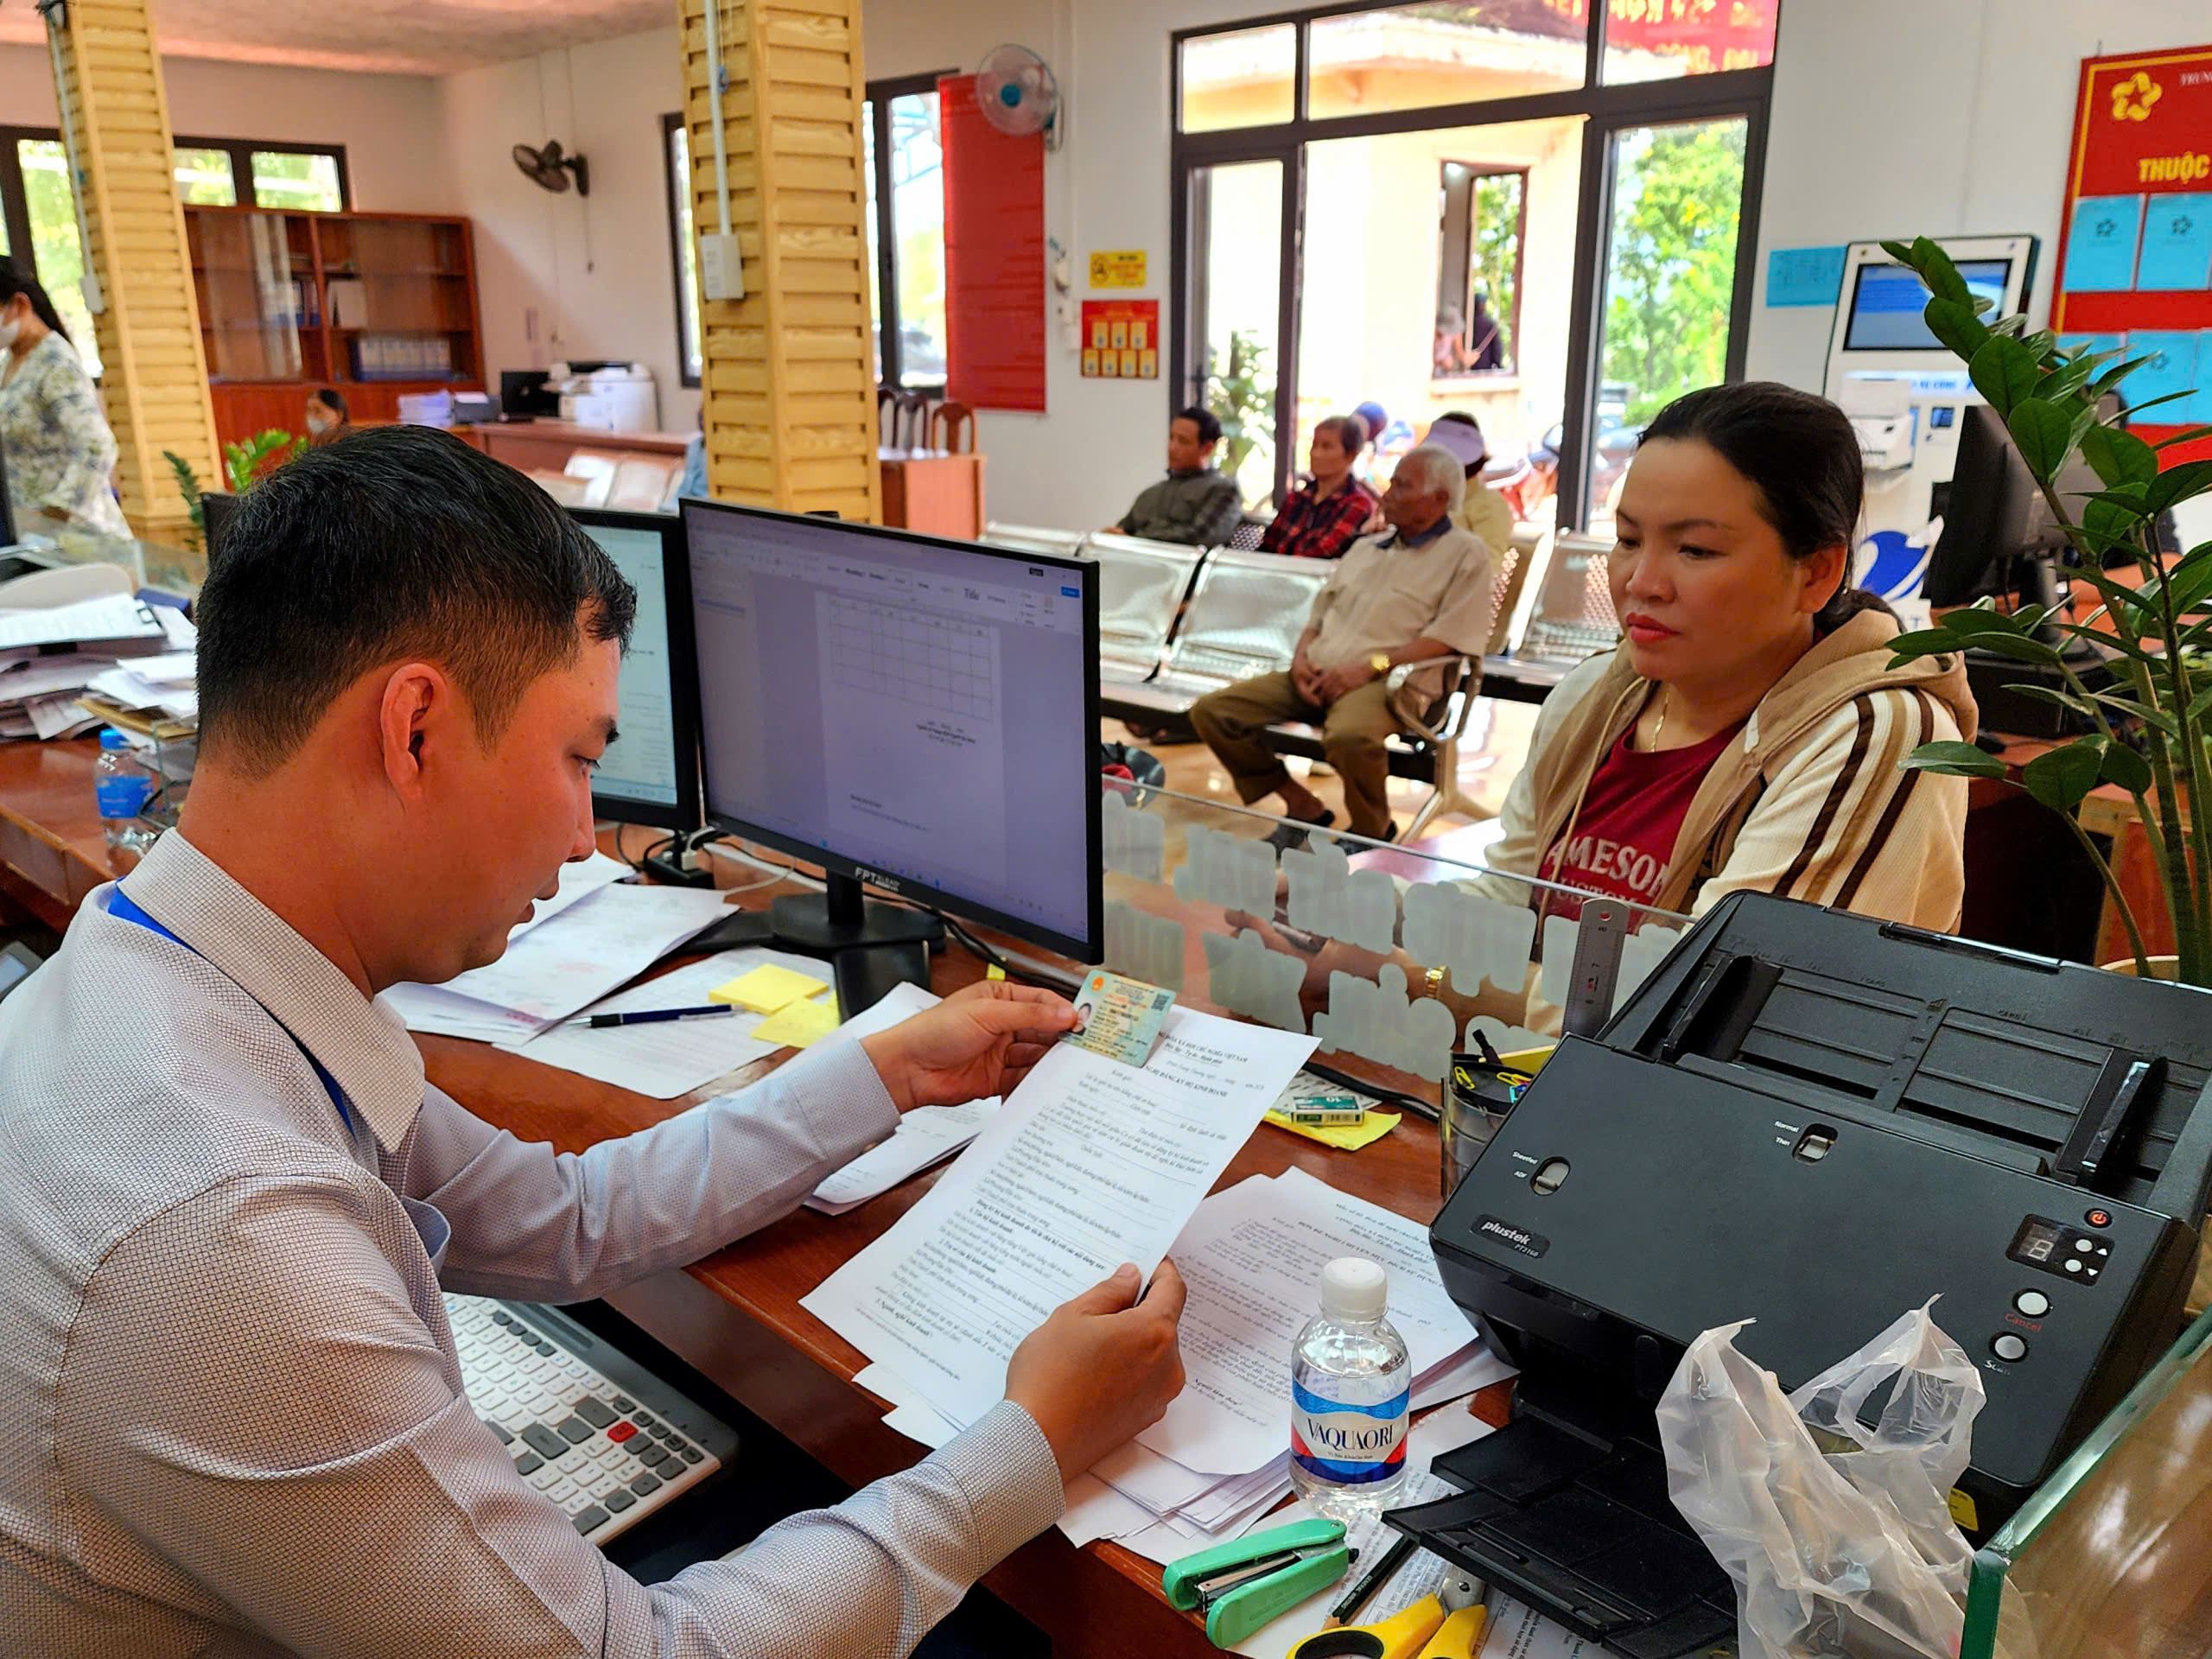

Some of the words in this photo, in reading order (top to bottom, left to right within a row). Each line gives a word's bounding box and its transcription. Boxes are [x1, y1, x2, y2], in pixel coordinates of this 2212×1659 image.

[2139, 150, 2210, 184] THUỘC
[855, 867, 877, 884] FPT
[1774, 1121, 1800, 1133] Normal
[1776, 1136, 1790, 1146] Thin
[1514, 1170, 1528, 1179] ADF
[1481, 1219, 1532, 1245] plustek
[1515, 1244, 1540, 1258] PT2160
[2005, 1313, 2043, 1332] Cancel
[1306, 1417, 1394, 1451] VAQUAORI
